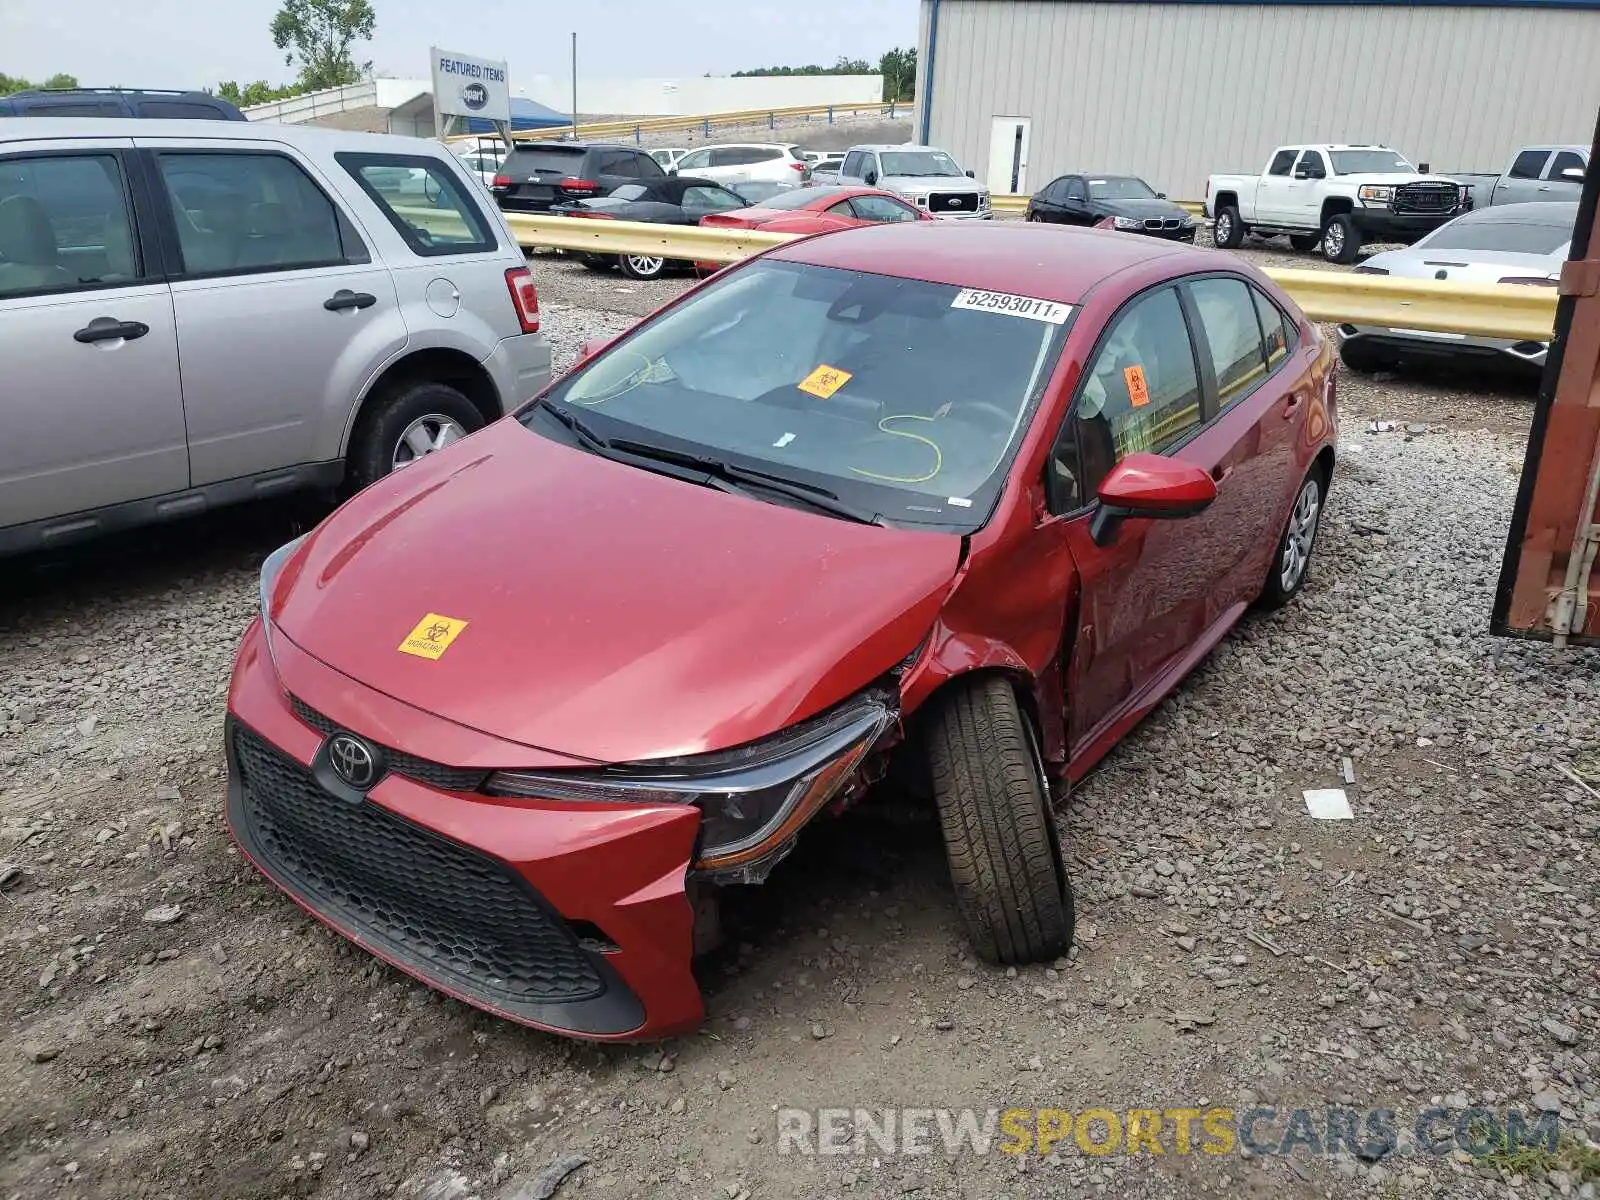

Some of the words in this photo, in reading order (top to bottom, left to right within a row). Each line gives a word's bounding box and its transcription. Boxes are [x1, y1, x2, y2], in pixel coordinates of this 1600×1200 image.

[440, 58, 481, 78] FEATURED
[483, 67, 505, 82] ITEMS
[967, 291, 1053, 317] 52593011
